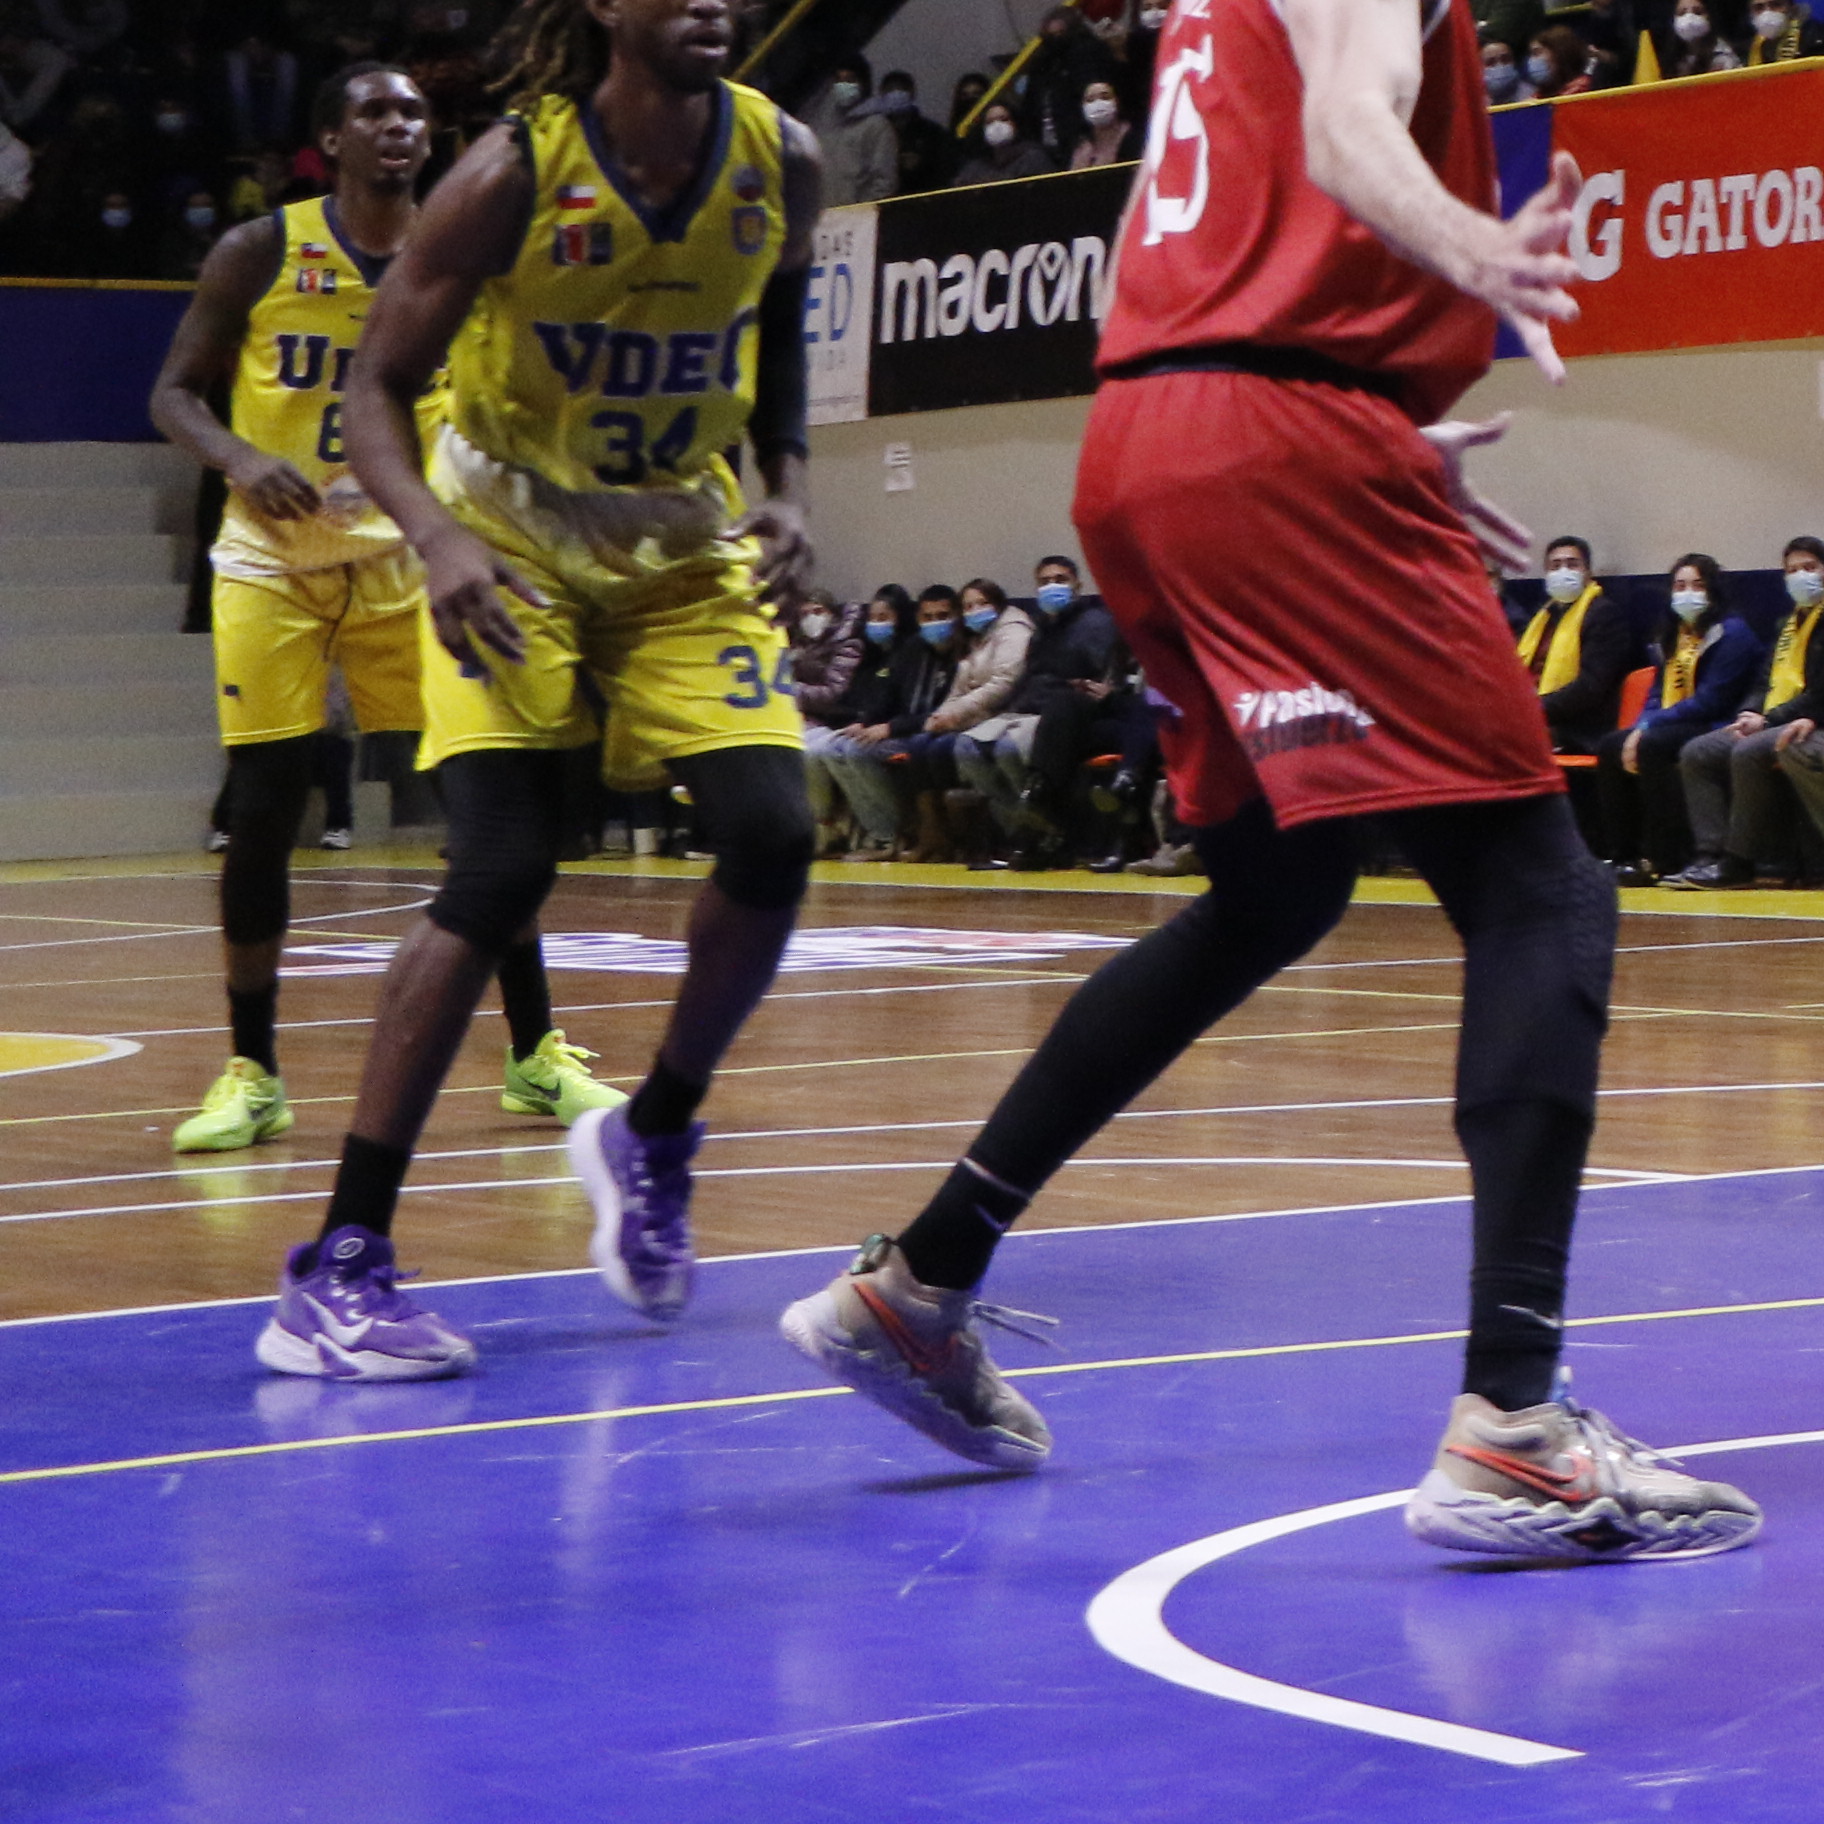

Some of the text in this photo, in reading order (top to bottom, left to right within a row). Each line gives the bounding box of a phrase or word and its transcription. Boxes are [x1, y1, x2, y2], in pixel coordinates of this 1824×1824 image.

[1568, 169, 1625, 282] G
[880, 234, 1107, 344] macron
[590, 404, 697, 487] 34
